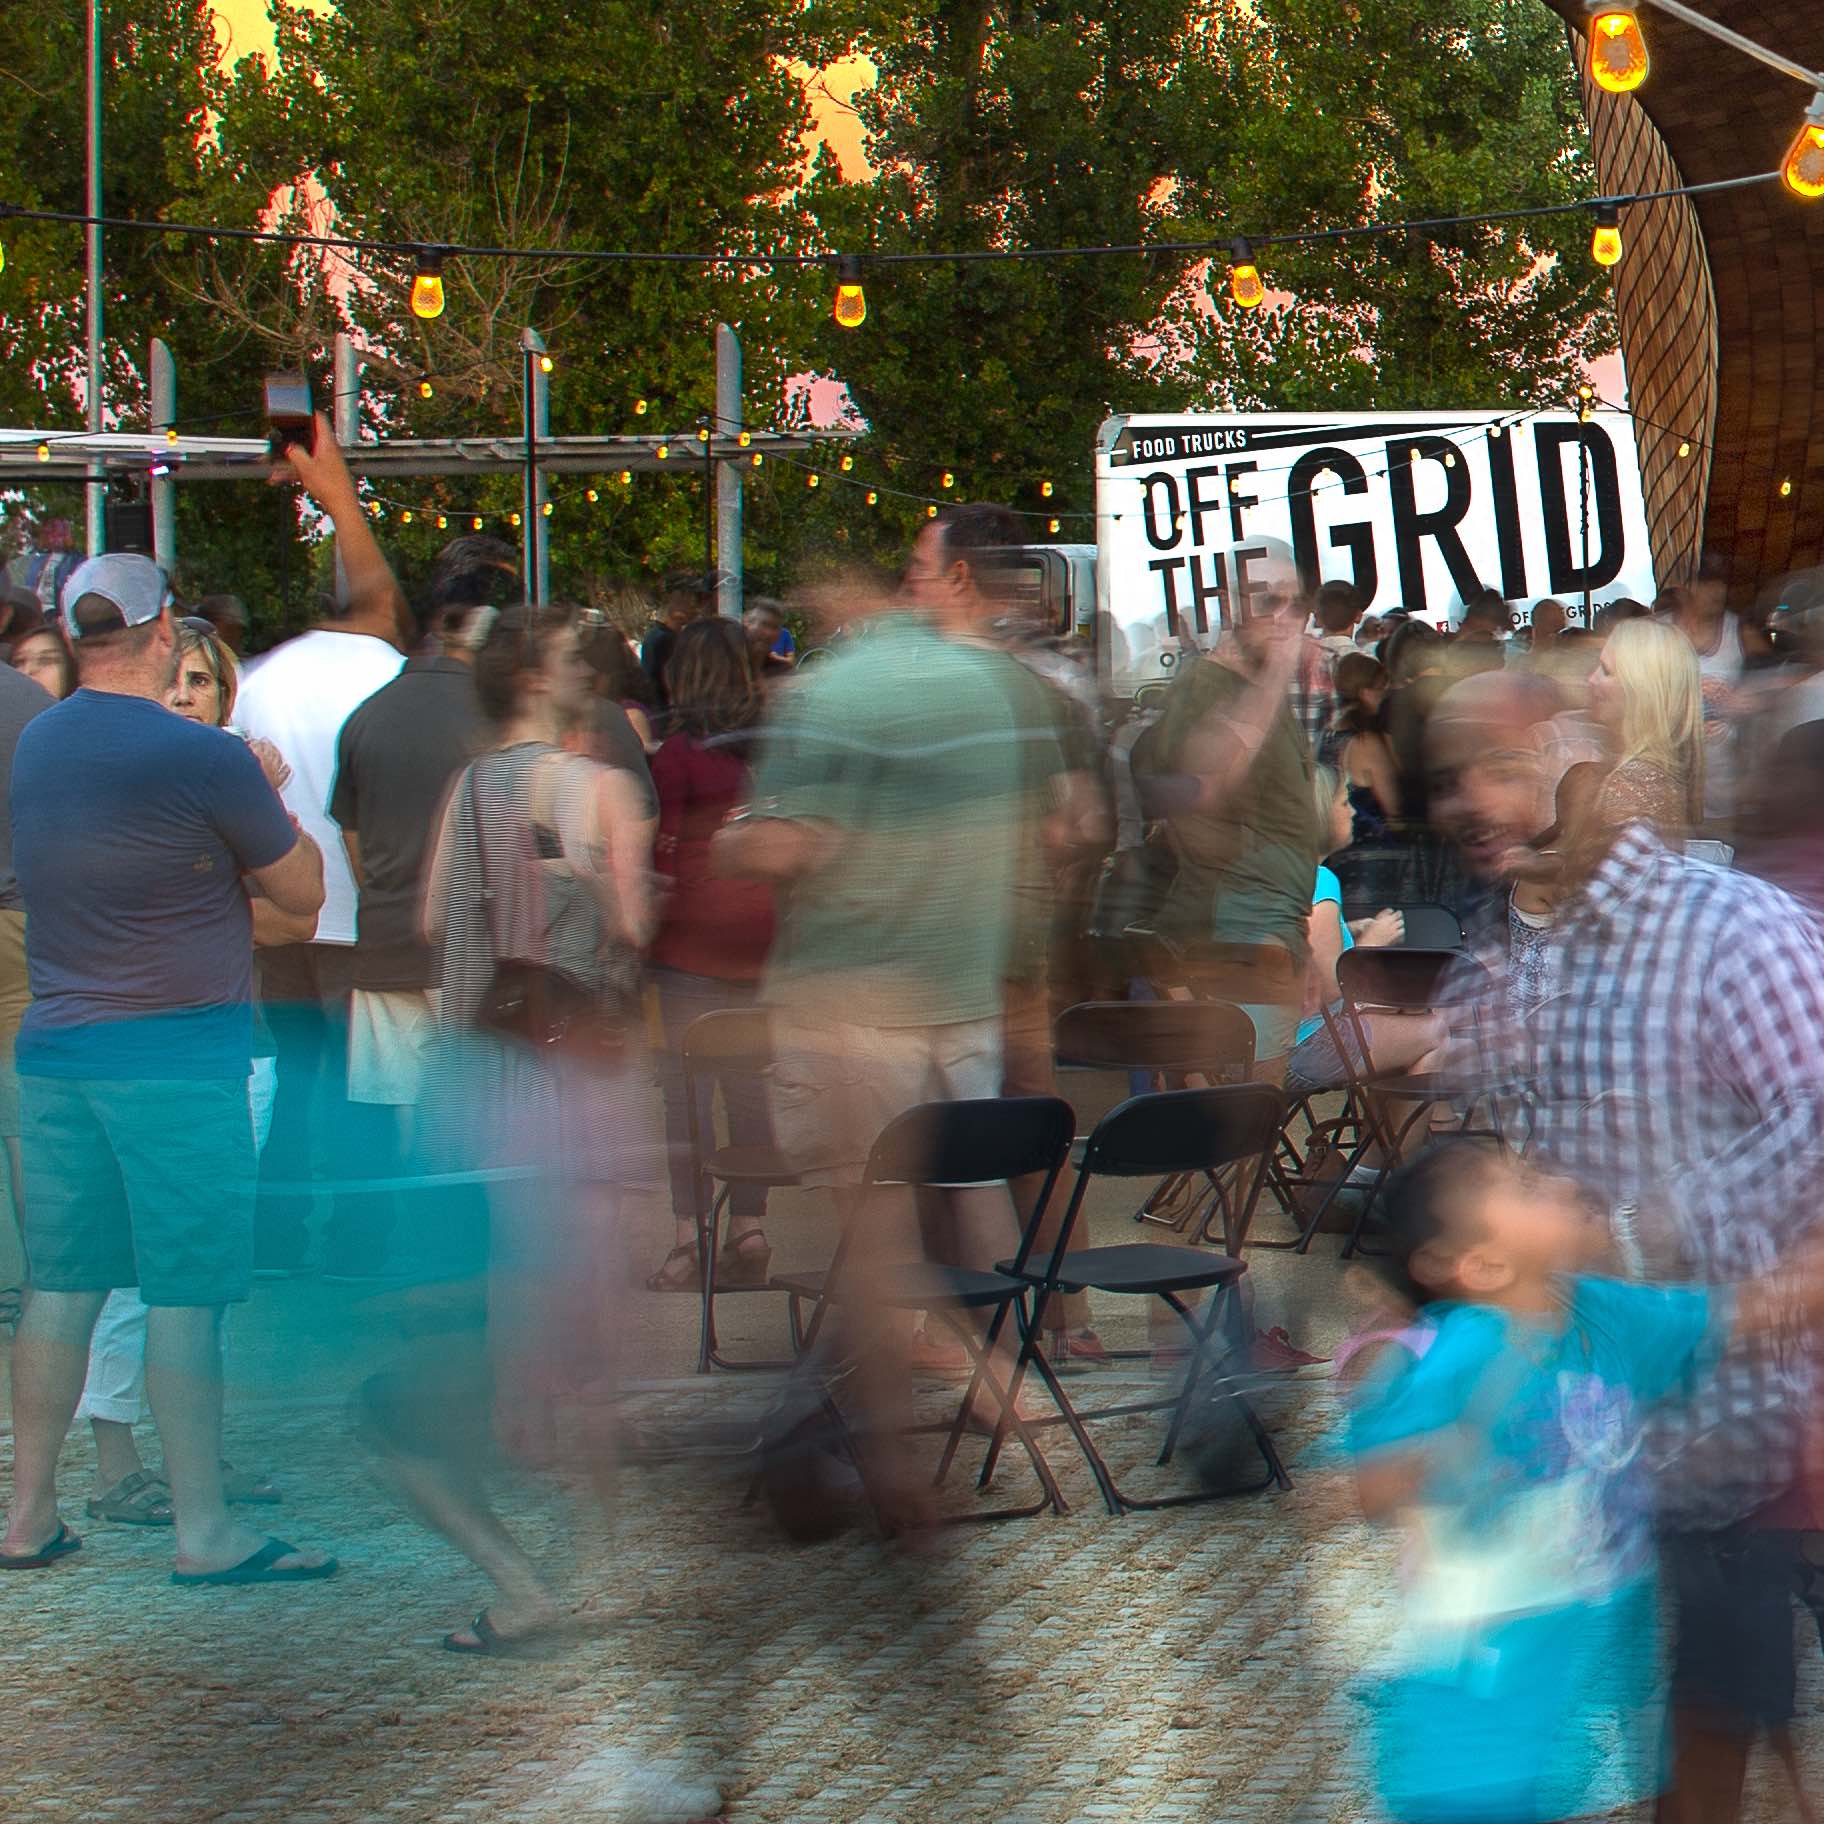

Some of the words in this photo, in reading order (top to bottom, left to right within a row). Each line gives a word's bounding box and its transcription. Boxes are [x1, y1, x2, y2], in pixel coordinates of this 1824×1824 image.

[1132, 437, 1176, 459] FOOD
[1180, 429, 1247, 454] TRUCKS
[1142, 461, 1259, 551] OFF
[1287, 422, 1626, 613] GRID
[1149, 547, 1274, 637] THE
